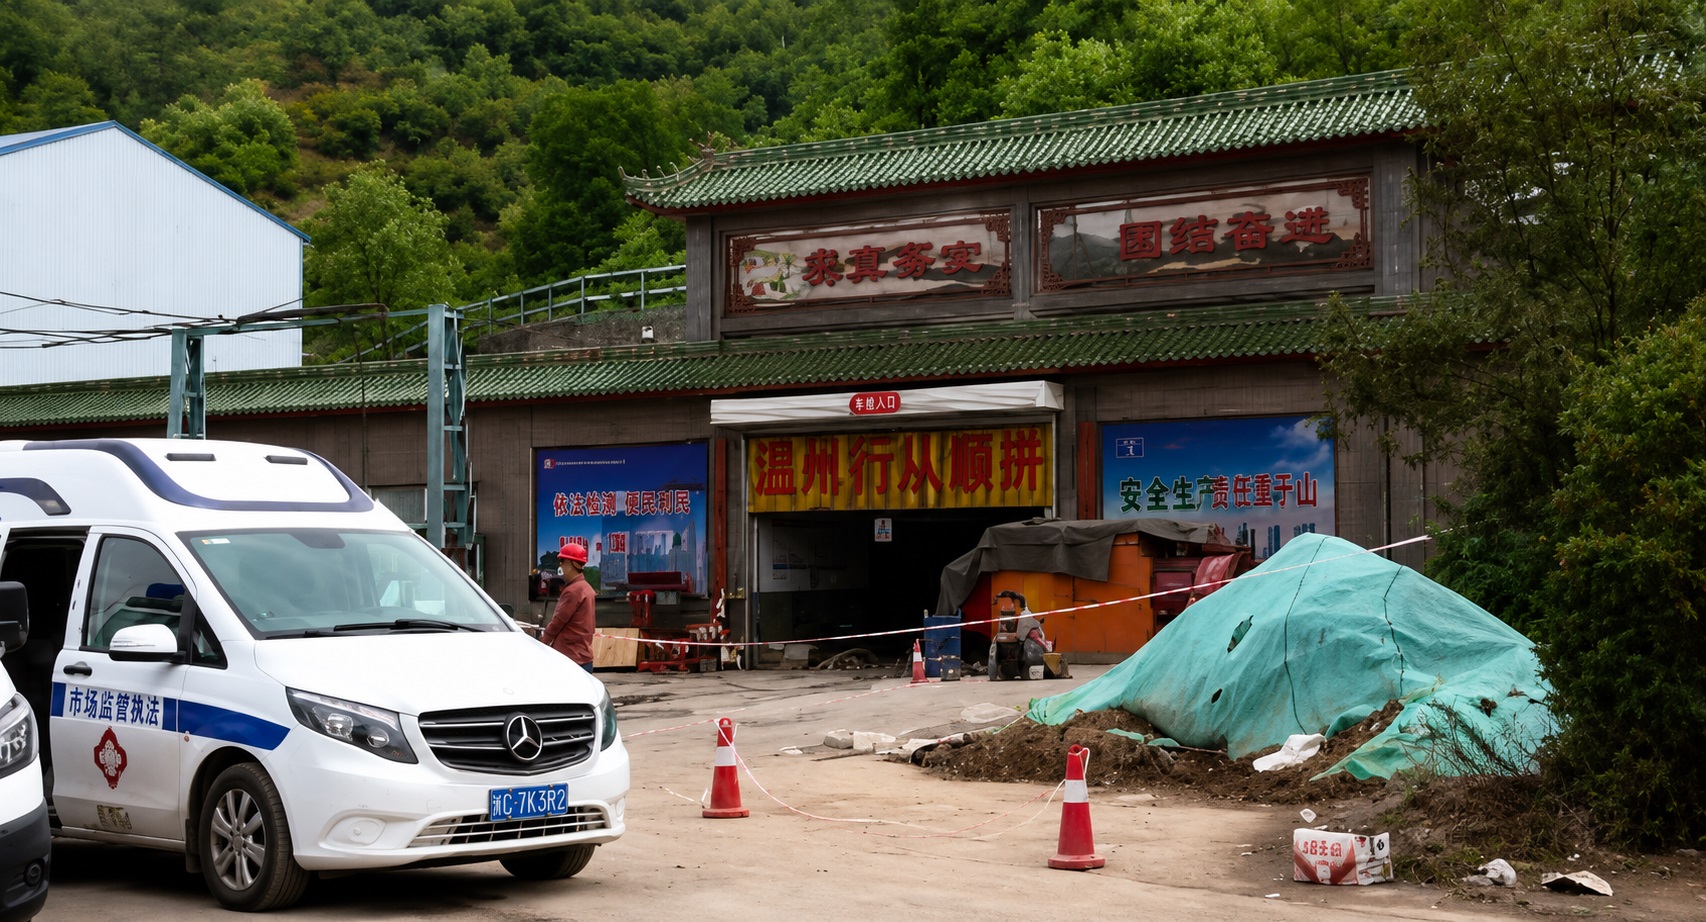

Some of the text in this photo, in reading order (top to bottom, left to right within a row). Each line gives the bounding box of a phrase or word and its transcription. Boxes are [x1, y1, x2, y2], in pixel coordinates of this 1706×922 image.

[754, 428, 1044, 496] 温州行从顺拼
[69, 686, 160, 727] 市场监管执法
